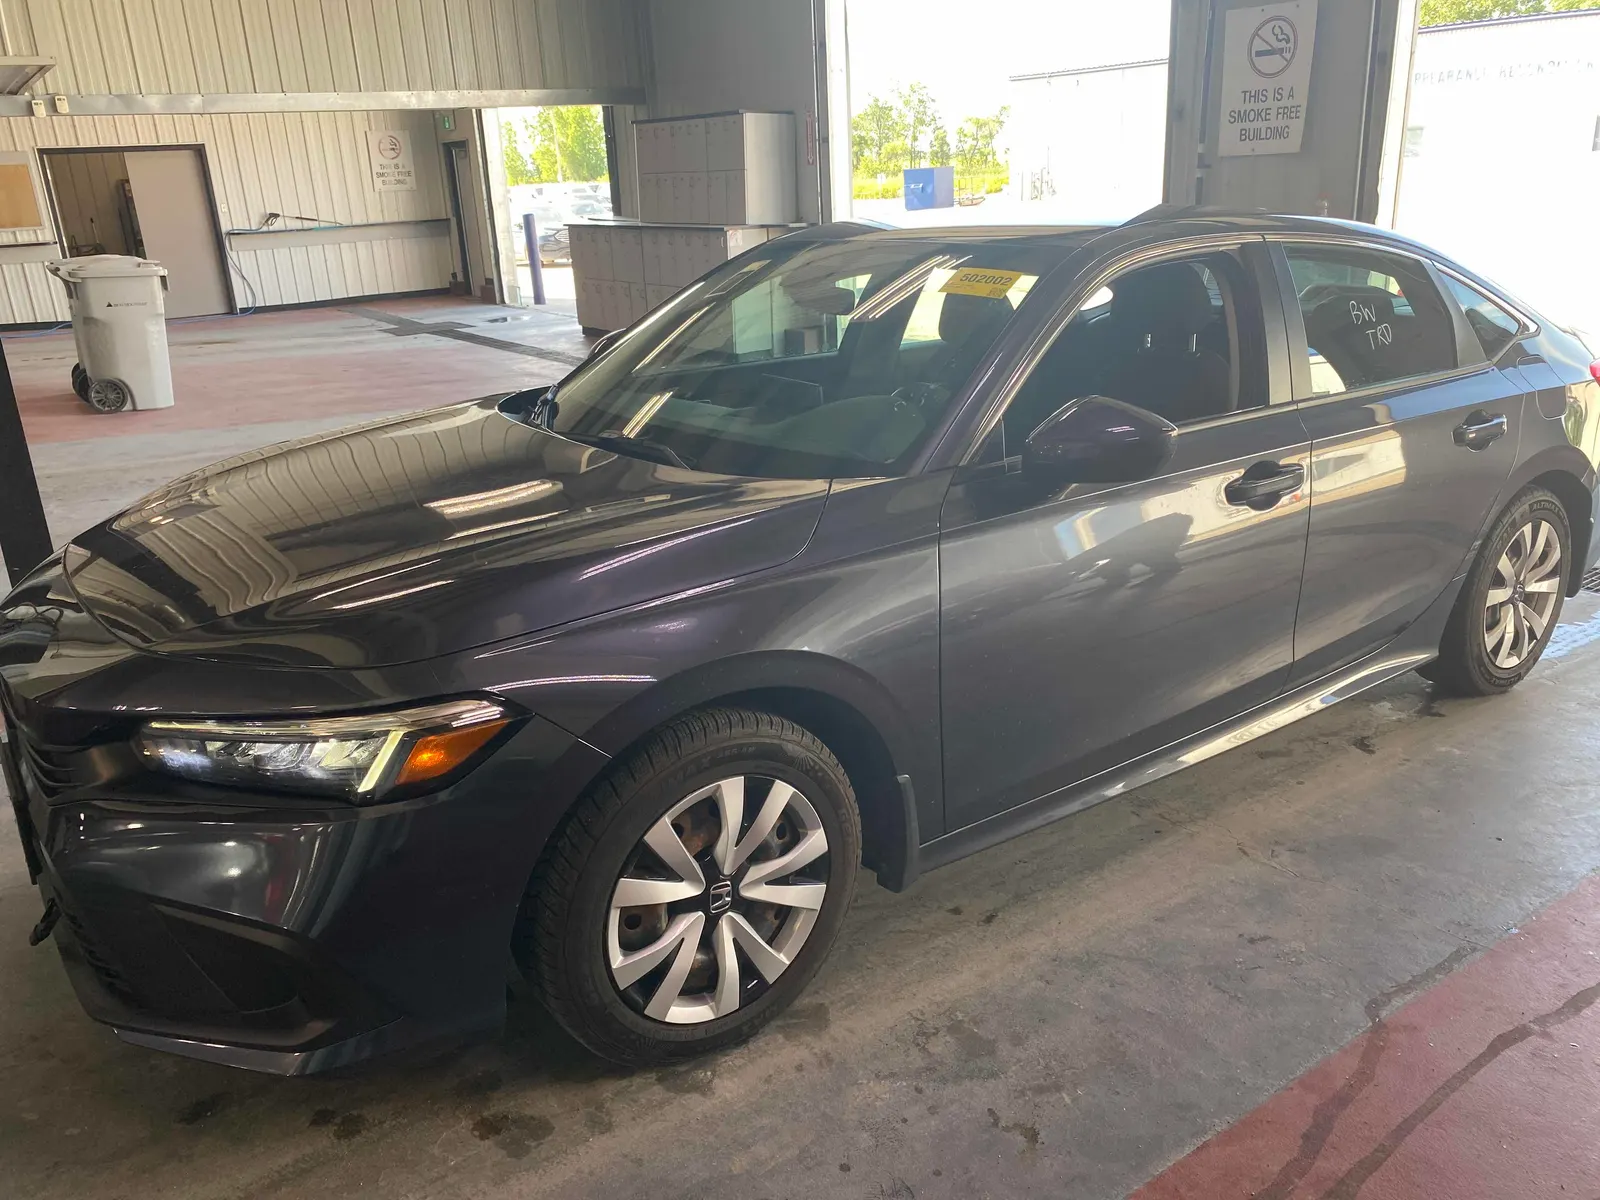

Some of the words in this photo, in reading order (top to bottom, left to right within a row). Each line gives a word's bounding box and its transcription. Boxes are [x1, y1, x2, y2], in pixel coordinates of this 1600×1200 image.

[1241, 88, 1269, 105] THIS
[1272, 87, 1284, 102] IS
[1287, 86, 1295, 101] A
[1228, 107, 1272, 125] SMOKE
[1275, 104, 1302, 121] FREE
[1239, 125, 1290, 142] BUILDING
[959, 273, 1013, 286] 502002
